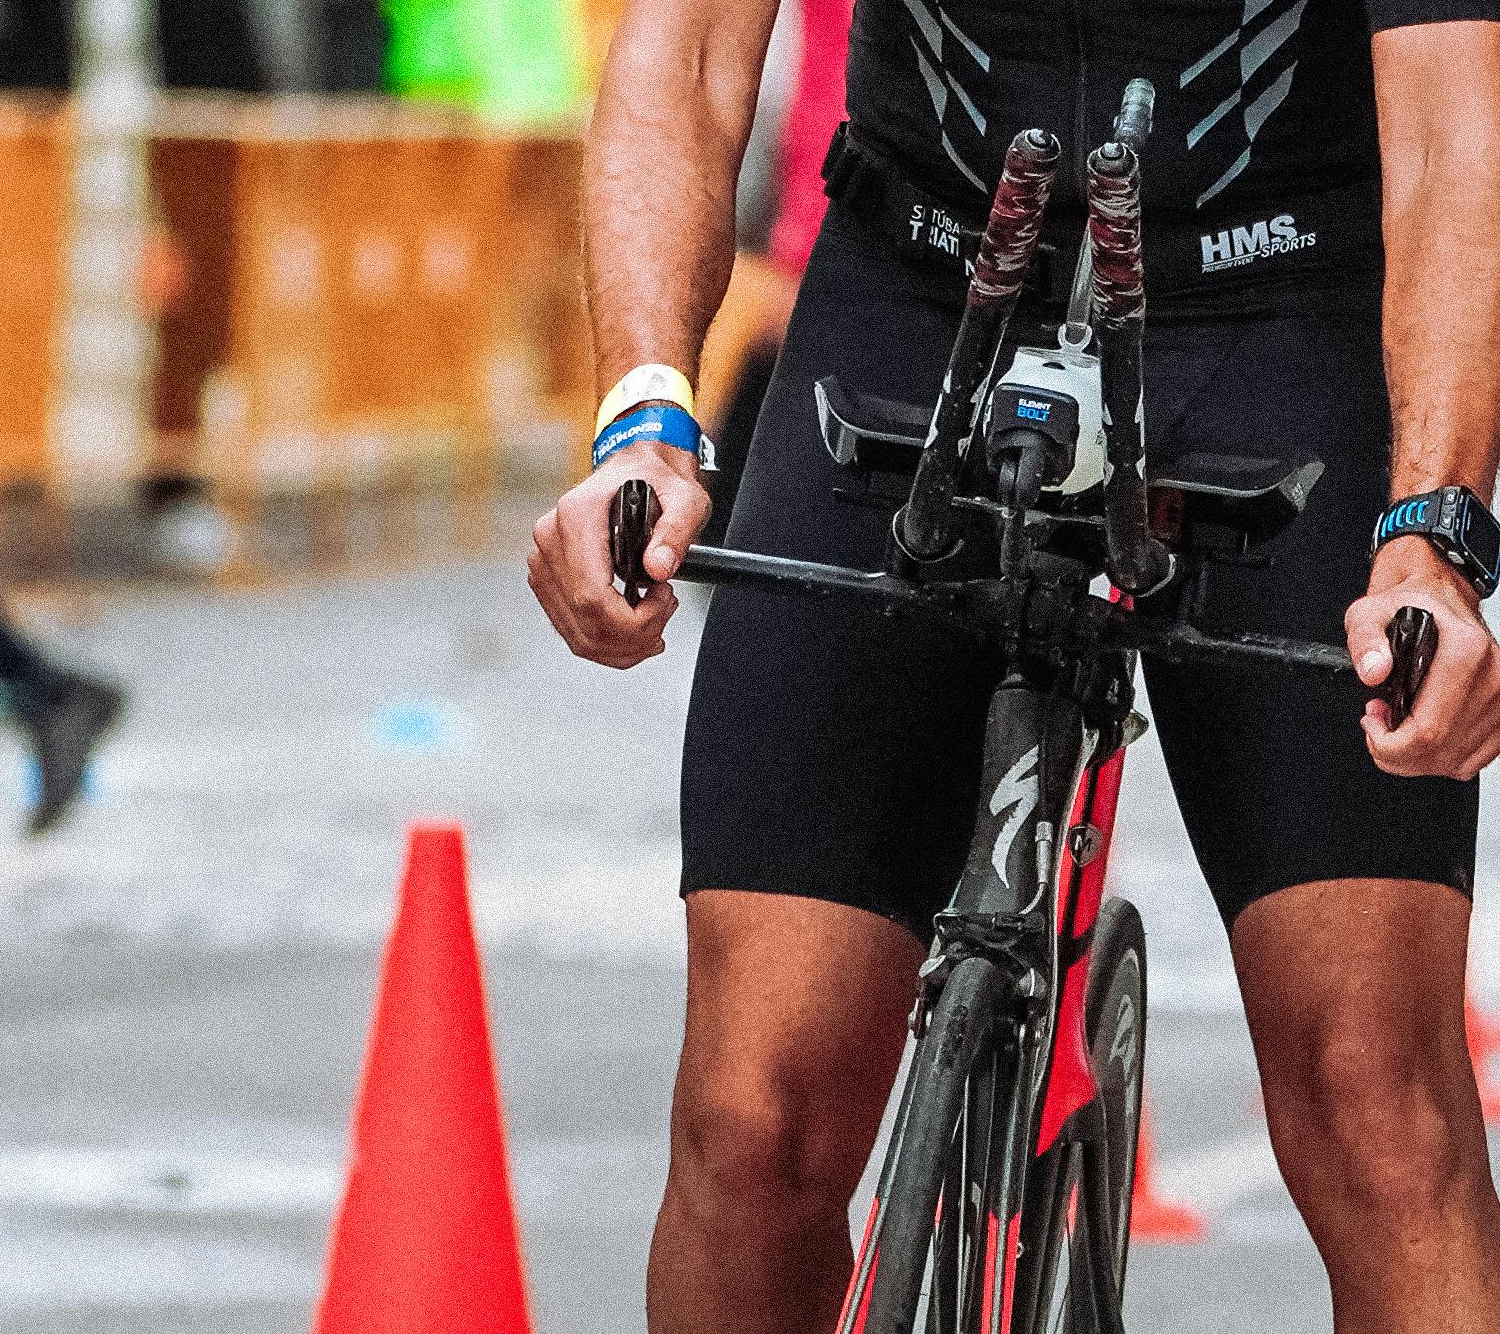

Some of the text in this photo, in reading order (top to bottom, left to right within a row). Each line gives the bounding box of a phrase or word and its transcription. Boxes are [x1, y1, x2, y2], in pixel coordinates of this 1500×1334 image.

[1200, 215, 1297, 264] HMS
[1260, 232, 1316, 258] SPORTS
[1017, 405, 1050, 422] BOLT
